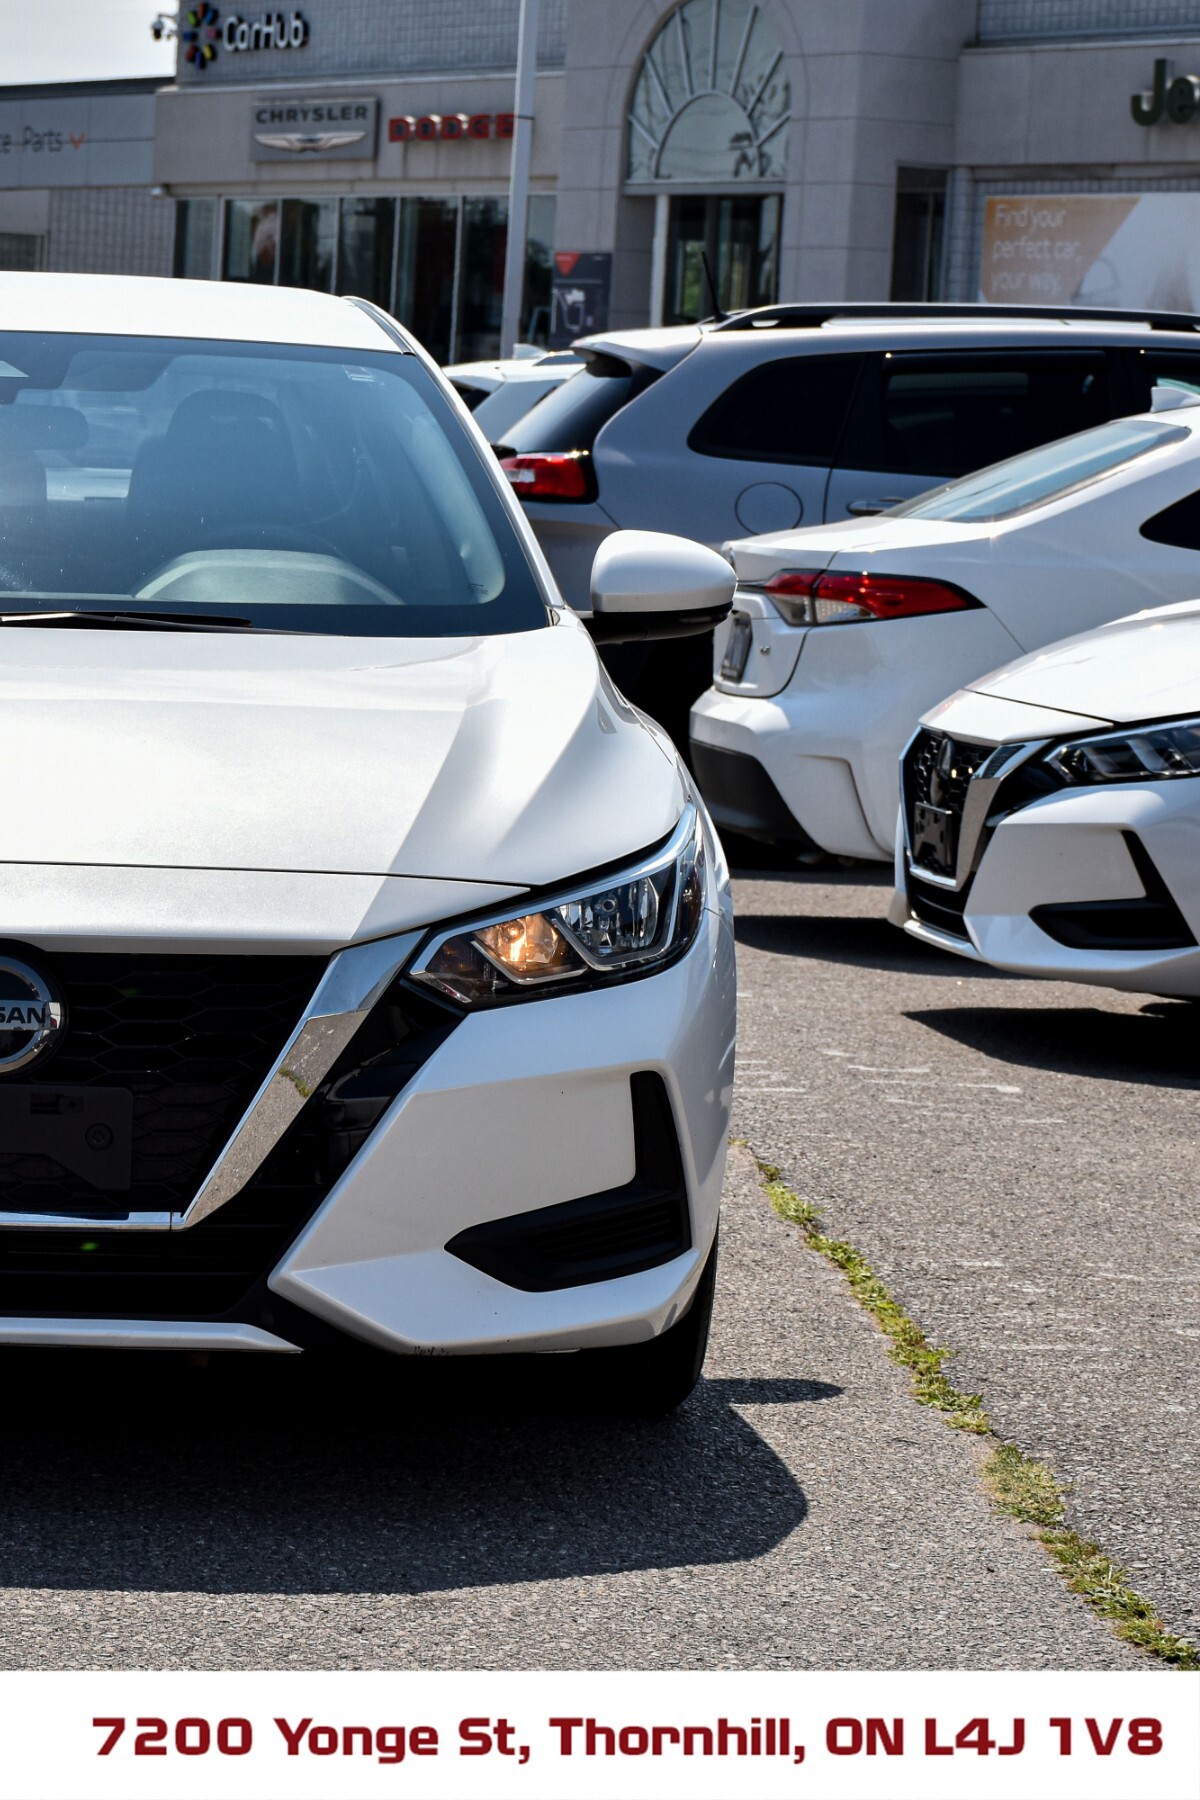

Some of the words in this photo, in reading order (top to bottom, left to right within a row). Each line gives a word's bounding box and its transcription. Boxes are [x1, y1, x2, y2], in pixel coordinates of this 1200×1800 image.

[222, 12, 309, 52] CarHub
[256, 104, 368, 124] CHRYSLER
[389, 112, 515, 142] DODGE
[23, 125, 63, 153] Parts
[994, 203, 1028, 228] Find
[1030, 208, 1067, 236] your
[992, 235, 1052, 263] perfect
[990, 271, 1027, 294] your
